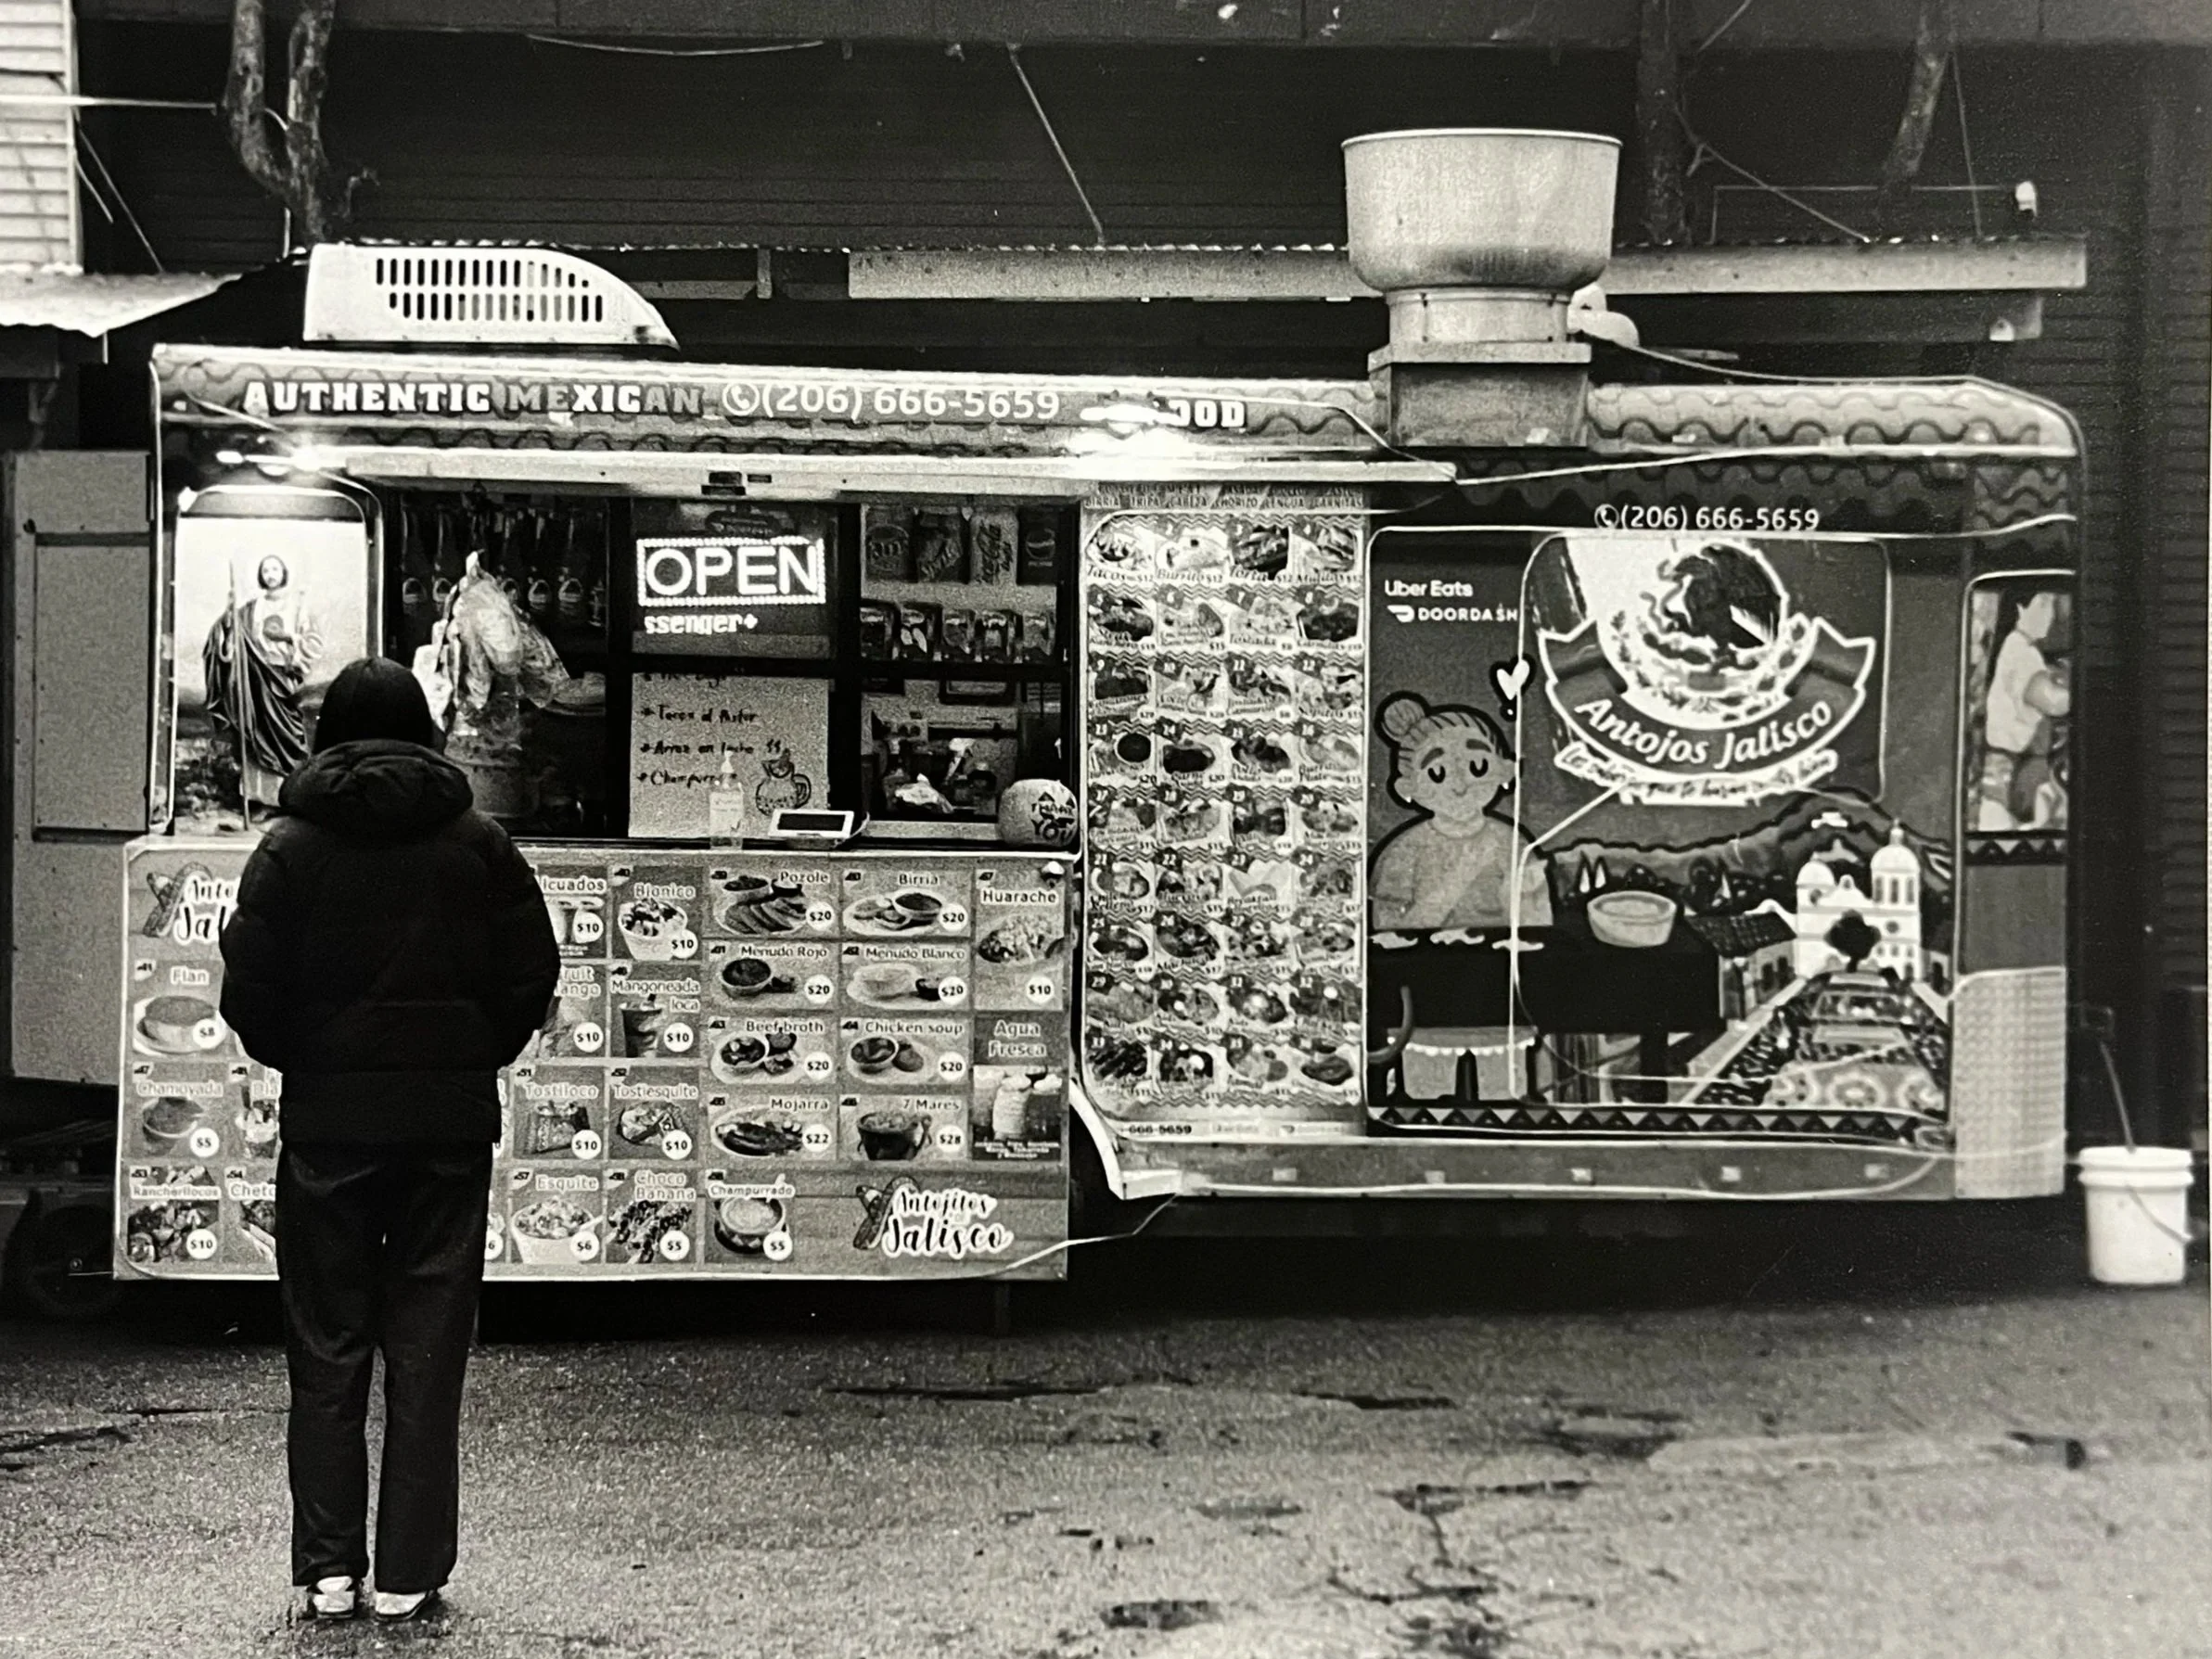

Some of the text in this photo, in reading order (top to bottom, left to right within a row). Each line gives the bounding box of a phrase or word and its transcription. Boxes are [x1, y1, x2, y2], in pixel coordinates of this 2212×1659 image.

[243, 381, 702, 415] AUTHENTIC MEXICAN
[761, 383, 1059, 421] (206) 666-5659
[1157, 399, 1247, 428] OOD
[1621, 505, 1820, 530] (206) 666-5659
[646, 545, 818, 595] OPEN
[1385, 580, 1473, 598] Uber Eats
[1418, 603, 1518, 622] DOORDASH
[1575, 699, 1709, 763] Antojos
[1714, 701, 1833, 769] Jalisco
[780, 871, 828, 884] Pozole
[899, 874, 939, 886] Birria
[543, 877, 605, 893] icuados
[635, 884, 695, 899] Bionico
[983, 891, 1056, 903] Huarache
[810, 911, 831, 921] $20
[942, 913, 965, 923] $20
[577, 923, 599, 933] $10
[671, 938, 694, 950] $10
[741, 945, 827, 959] Menudo Rojo
[866, 947, 965, 959] Menudo Blanco
[172, 966, 209, 985] Flan
[563, 967, 595, 981] ruit
[560, 984, 601, 999] ango
[611, 979, 701, 996] Mangoneada
[808, 985, 830, 995] $20
[941, 986, 964, 996] $20
[1029, 985, 1051, 995] $10
[671, 998, 700, 1012] loca
[746, 1021, 824, 1033] Beef broth
[866, 1021, 964, 1036] Chicken soup
[994, 1020, 1041, 1038] Agua
[577, 1032, 599, 1042] $10
[667, 1032, 689, 1042] $10
[988, 1040, 1047, 1058] Fresca
[807, 1061, 829, 1071] $20
[940, 1062, 963, 1071] $20
[526, 1083, 598, 1099] Tostiloco
[614, 1083, 697, 1101] Tostiesquite
[771, 1098, 828, 1111] Mojarra
[916, 1099, 960, 1110] Mares
[196, 1138, 211, 1148] $5
[806, 1133, 828, 1143] $22
[940, 1134, 961, 1144] $28
[575, 1141, 597, 1151] $10
[665, 1141, 688, 1151] $10
[535, 1176, 598, 1192] Esquite
[636, 1171, 686, 1186] Choco
[636, 1187, 696, 1201] Banana
[710, 1185, 793, 1197] Champurrado
[886, 1216, 1009, 1254] Jalisco
[190, 1239, 212, 1250] $10
[487, 1241, 495, 1250] 6
[577, 1241, 592, 1251] $6
[668, 1241, 682, 1251] $5
[770, 1242, 785, 1250] $5
